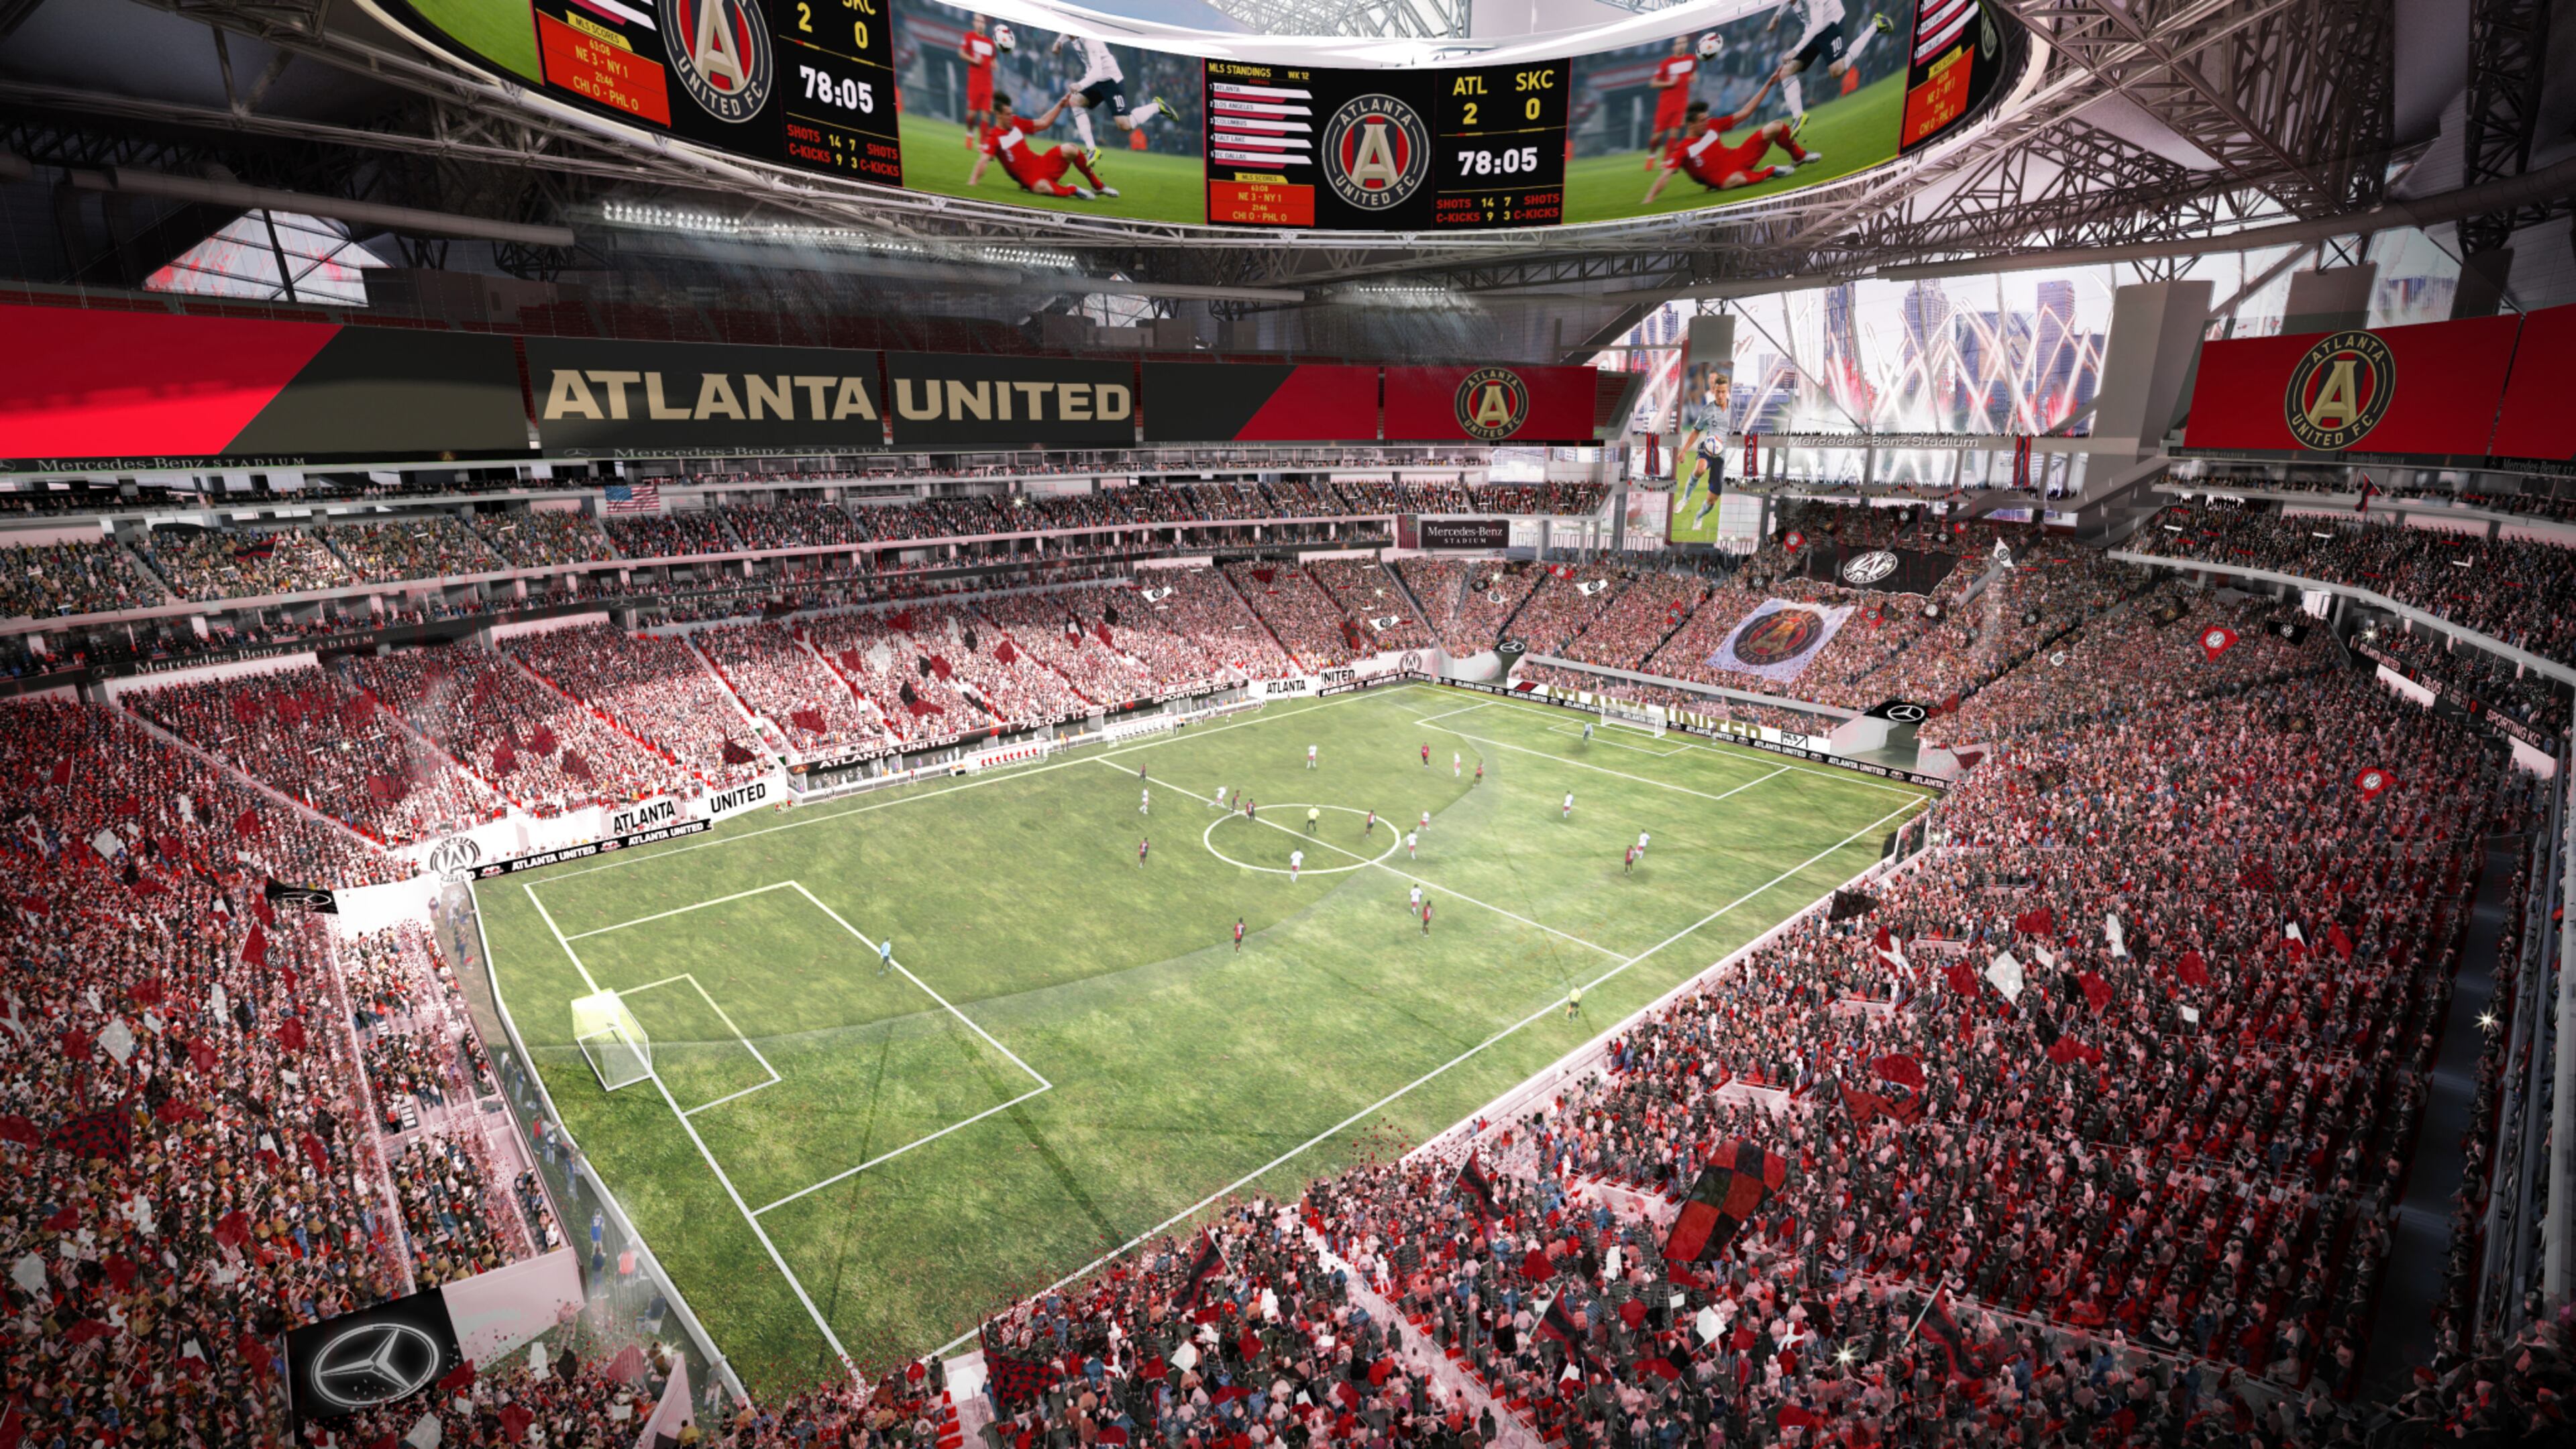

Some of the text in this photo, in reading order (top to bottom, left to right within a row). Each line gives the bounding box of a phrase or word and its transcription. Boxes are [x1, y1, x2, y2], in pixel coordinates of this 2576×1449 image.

[576, 17, 620, 44] MLS SCORES
[797, 2, 869, 49] 2 0
[589, 40, 610, 56] 63:08
[1830, 36, 1842, 54] 10
[575, 45, 628, 78] NE 3 NY 1
[1208, 62, 1309, 80] MLS STANDINGS WK 12
[595, 72, 614, 87] 21:46
[678, 56, 763, 116] UNITED FC
[800, 64, 873, 114] 78:05
[1452, 69, 1555, 96] ATL SKC
[573, 76, 590, 93] CHI
[609, 90, 629, 108] PHL
[1113, 95, 1125, 109] 10
[1339, 99, 1412, 126] ATLANTA
[1463, 97, 1540, 125] 2 0
[1216, 118, 1247, 126] COLUMBUS
[787, 123, 898, 161] SHOTS 14 7 SHOTS
[789, 142, 900, 177] C-KICKS 9 3 C-KICKS
[1458, 146, 1538, 176] 78:05
[1238, 192, 1281, 203] NE 3 NY 1
[1336, 175, 1415, 205] UNITED FC
[1436, 193, 1560, 209] SHOTS 14 7 SHOTS
[1232, 211, 1247, 219] CHI
[1263, 213, 1279, 221] PHL
[1436, 207, 1559, 223] C-KICKS 9 3 C-KICKS
[2312, 335, 2385, 363] ATLANTA
[1467, 370, 1517, 388] ATLANTA
[543, 368, 1131, 421] ATLANTA UNITED
[1464, 417, 1520, 437] UNITED FC
[2292, 413, 2373, 446] UNITED FC
[1786, 436, 1979, 447] Mercedes-Benz Stadium
[614, 447, 889, 458] Mercedes-Benz STADIUM
[36, 458, 306, 472] Mercedes-Benz STADIUM
[1428, 526, 1503, 536] Mercedes-Benz
[657, 575, 920, 605] Mercedes-Benz STADIUM
[134, 635, 374, 677] Mercedes-Benz STADIUM
[2359, 643, 2402, 672] ATLANTA UNITED
[1152, 684, 1229, 705] SPORTING KC
[1266, 680, 1306, 695] ATLANTA
[1455, 681, 1493, 693] ATLANTA UNITED
[2420, 674, 2443, 695] 78:05
[1507, 690, 1548, 703] ATLANTA UNITED
[1563, 700, 1586, 710] ATLANTA
[1622, 712, 1646, 722] ATLANTA
[1664, 708, 1762, 739] UNITED
[1685, 725, 1711, 737] ATLANTA
[1782, 732, 1799, 742] MLS
[2485, 708, 2542, 748] SPORTING KC
[818, 736, 961, 769] ATLANTA UNITED
[1754, 740, 1807, 758] ATLANTA UNITED
[1827, 757, 1886, 776] ATLANTA UNITED
[1910, 775, 1945, 789] ATLANTA
[613, 783, 766, 834] ATLANTA UNITED
[628, 822, 704, 847] ATLANTA UNITED
[512, 845, 596, 871] ATLANTA UNITED
